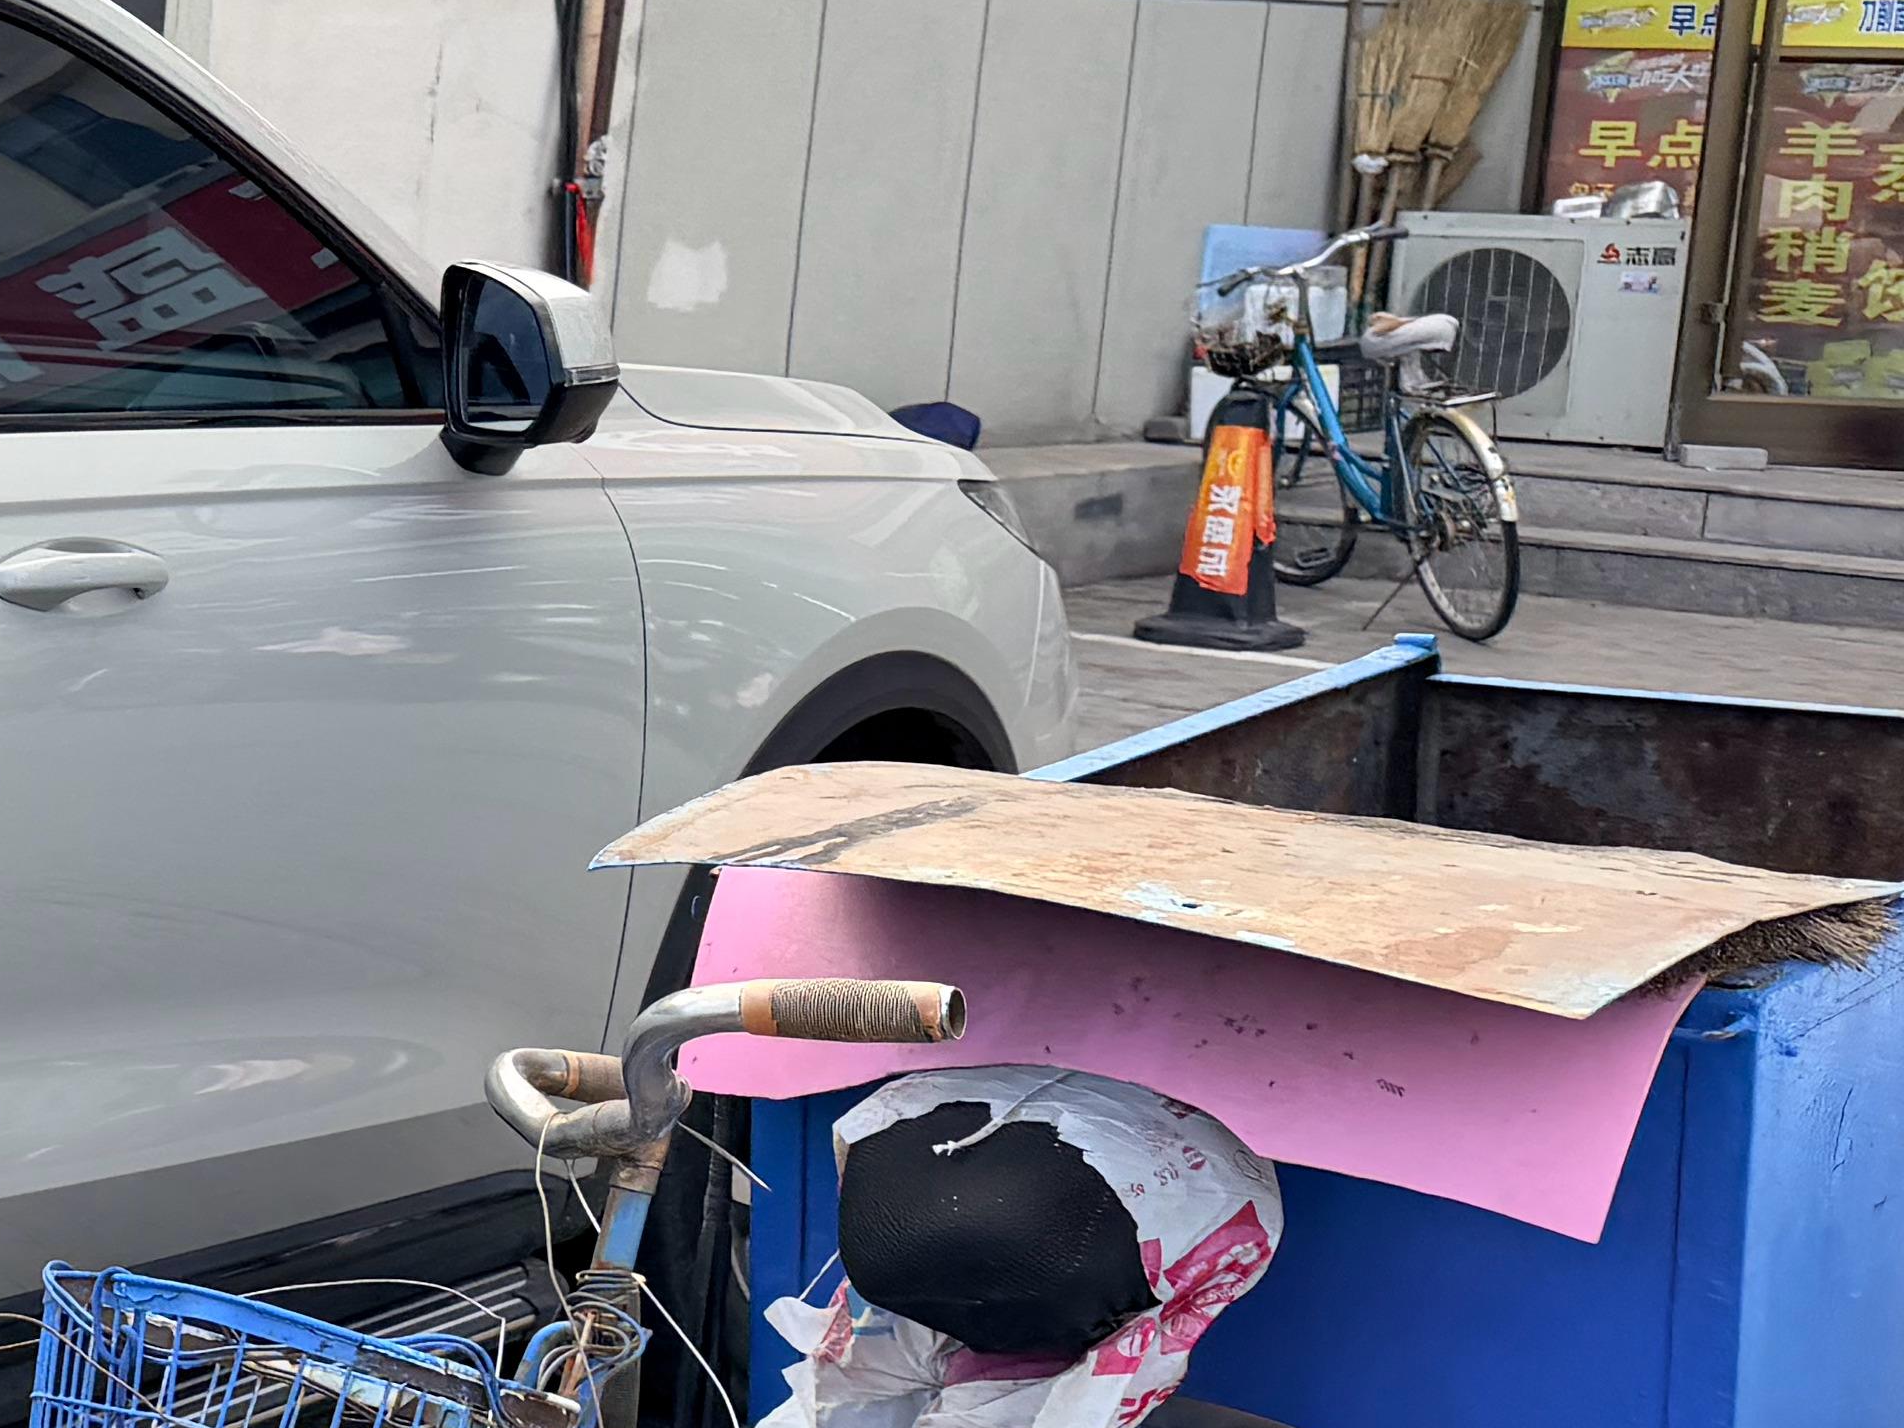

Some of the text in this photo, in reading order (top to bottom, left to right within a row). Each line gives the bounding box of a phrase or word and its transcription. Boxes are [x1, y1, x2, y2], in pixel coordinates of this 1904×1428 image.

[1578, 118, 1704, 169] 早点
[1756, 120, 1866, 328] 羊肉稍麦
